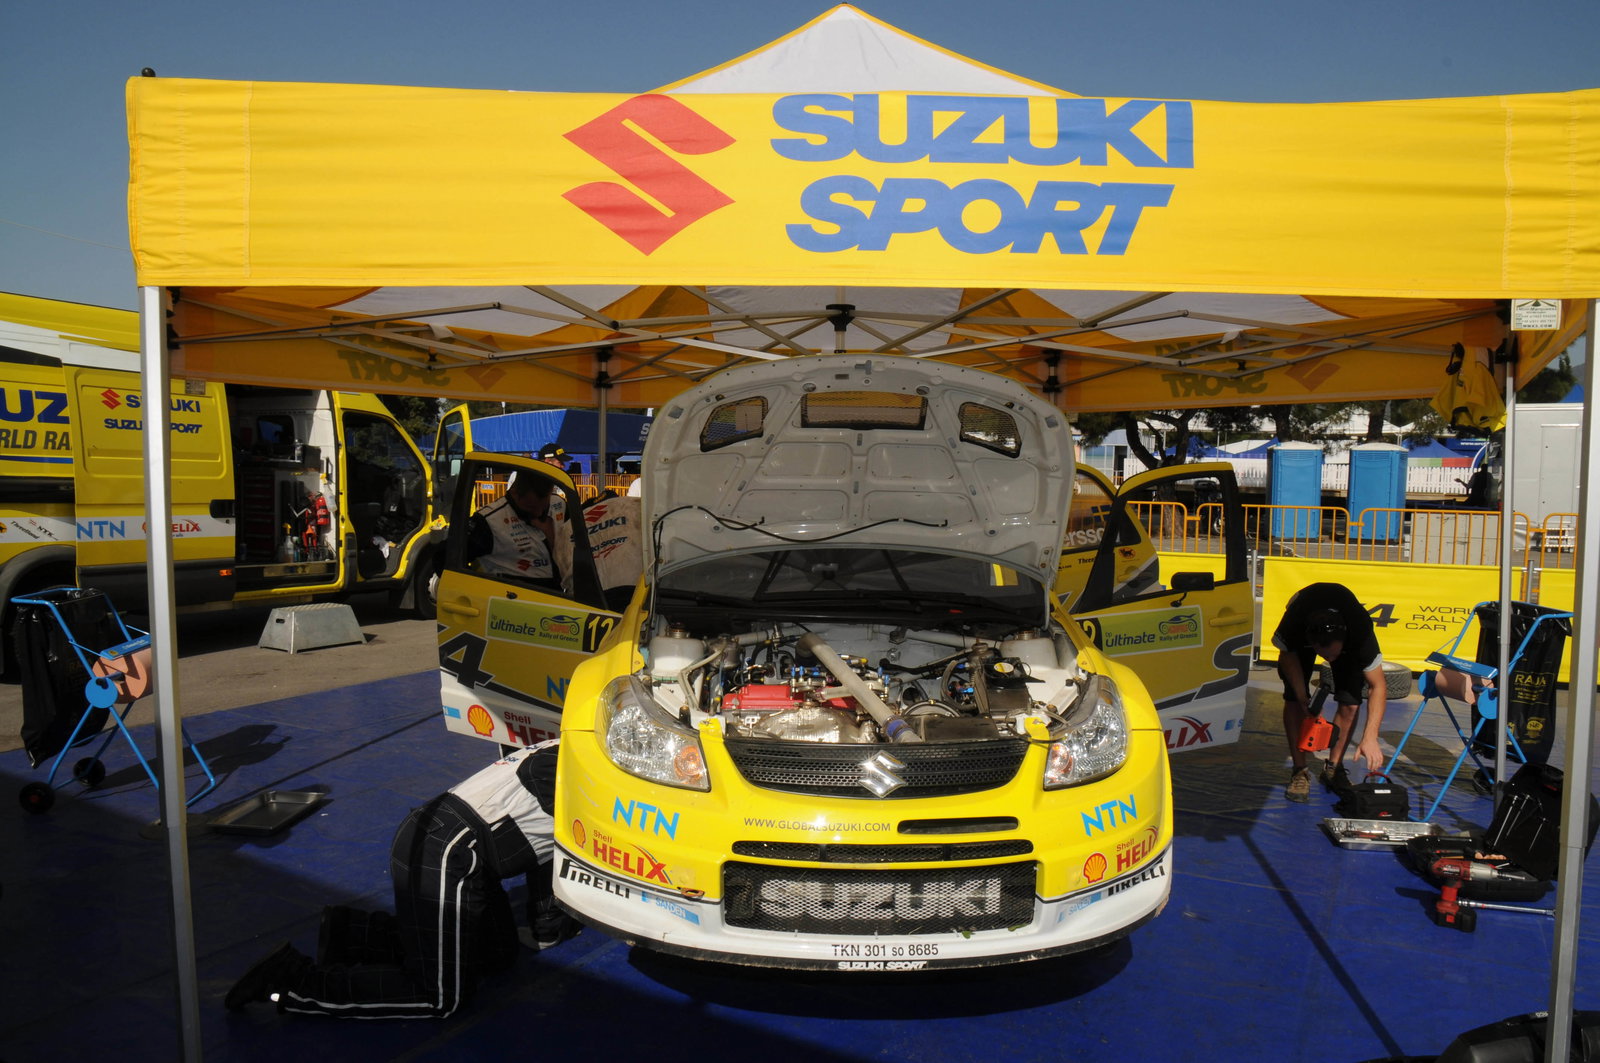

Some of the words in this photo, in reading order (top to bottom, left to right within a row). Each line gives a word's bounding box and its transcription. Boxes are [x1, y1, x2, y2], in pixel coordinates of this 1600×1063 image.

[770, 93, 1195, 169] SUZUKI
[785, 175, 1176, 256] SPORT
[77, 520, 125, 539] NTN
[171, 519, 203, 533] ELIX
[1419, 605, 1473, 615] WORL
[490, 618, 536, 636] ultimate
[588, 615, 615, 652] 12
[1405, 622, 1447, 632] CAR
[1105, 631, 1156, 648] ultimate
[504, 711, 531, 725] Shell
[612, 795, 680, 841] NTN
[1080, 794, 1138, 837] NTN
[593, 829, 613, 844] Shell
[1116, 838, 1135, 852] Shell
[592, 839, 673, 885] HELIX
[559, 858, 630, 899] PIRELLI
[760, 878, 1001, 920] SUZUKI
[831, 944, 860, 957] TKN
[864, 944, 886, 957] 301
[908, 943, 939, 956] 8685
[838, 961, 884, 970] SUZUKI
[885, 960, 928, 970] SPORT
